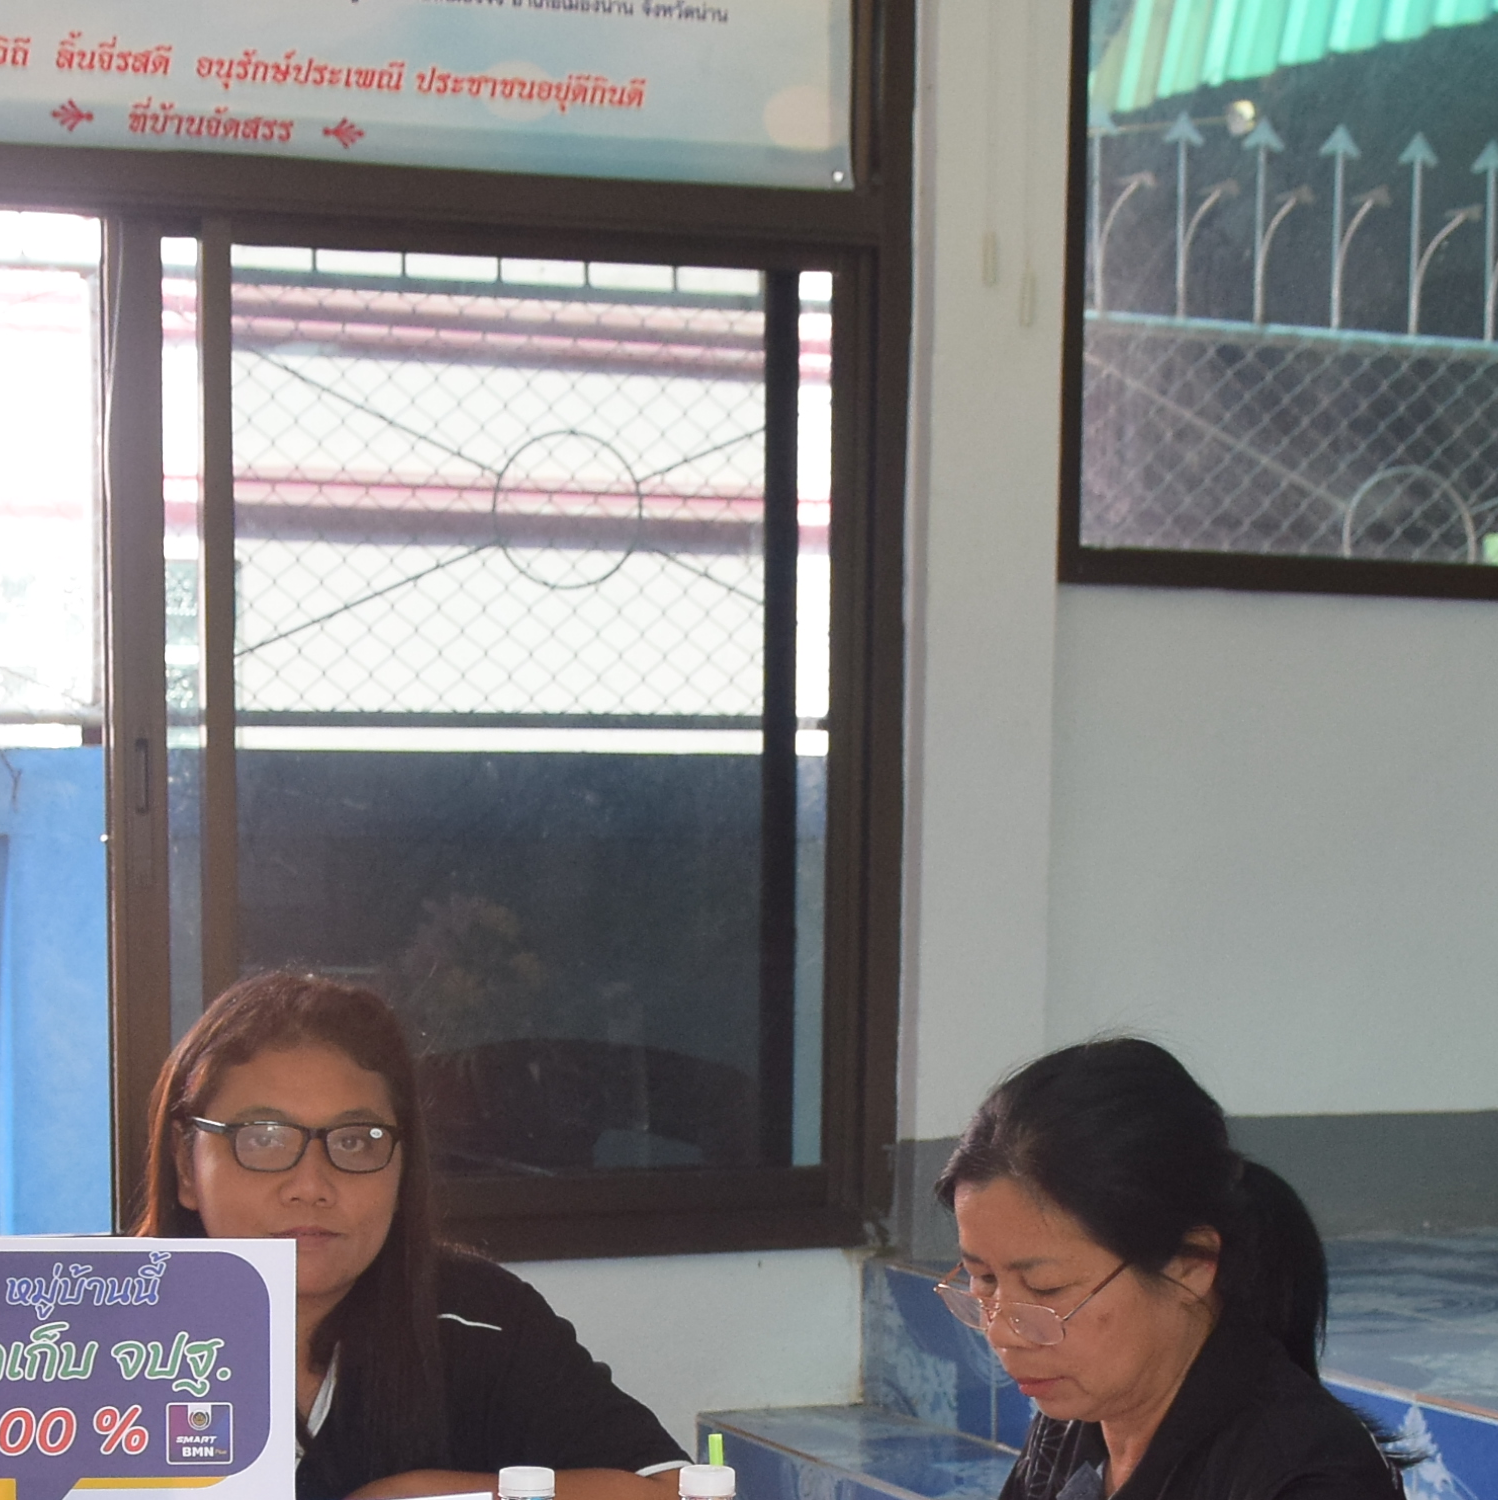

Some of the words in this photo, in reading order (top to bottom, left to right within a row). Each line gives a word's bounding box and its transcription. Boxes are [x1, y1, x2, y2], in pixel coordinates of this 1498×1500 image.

[55, 30, 173, 76] ลิ้นจี่รสดี
[196, 49, 406, 91] อนุรักษ์ประเพณี
[415, 66, 647, 114] ประชาชนอยู่ดีกินดี
[128, 96, 294, 142] ที่บ้านจัดสรร
[4, 1251, 171, 1321] หมู่บ้านนี้
[110, 1334, 233, 1396] จปฐ.
[92, 1404, 150, 1458] %
[176, 1435, 218, 1445] SMART
[182, 1446, 215, 1458] BMN
